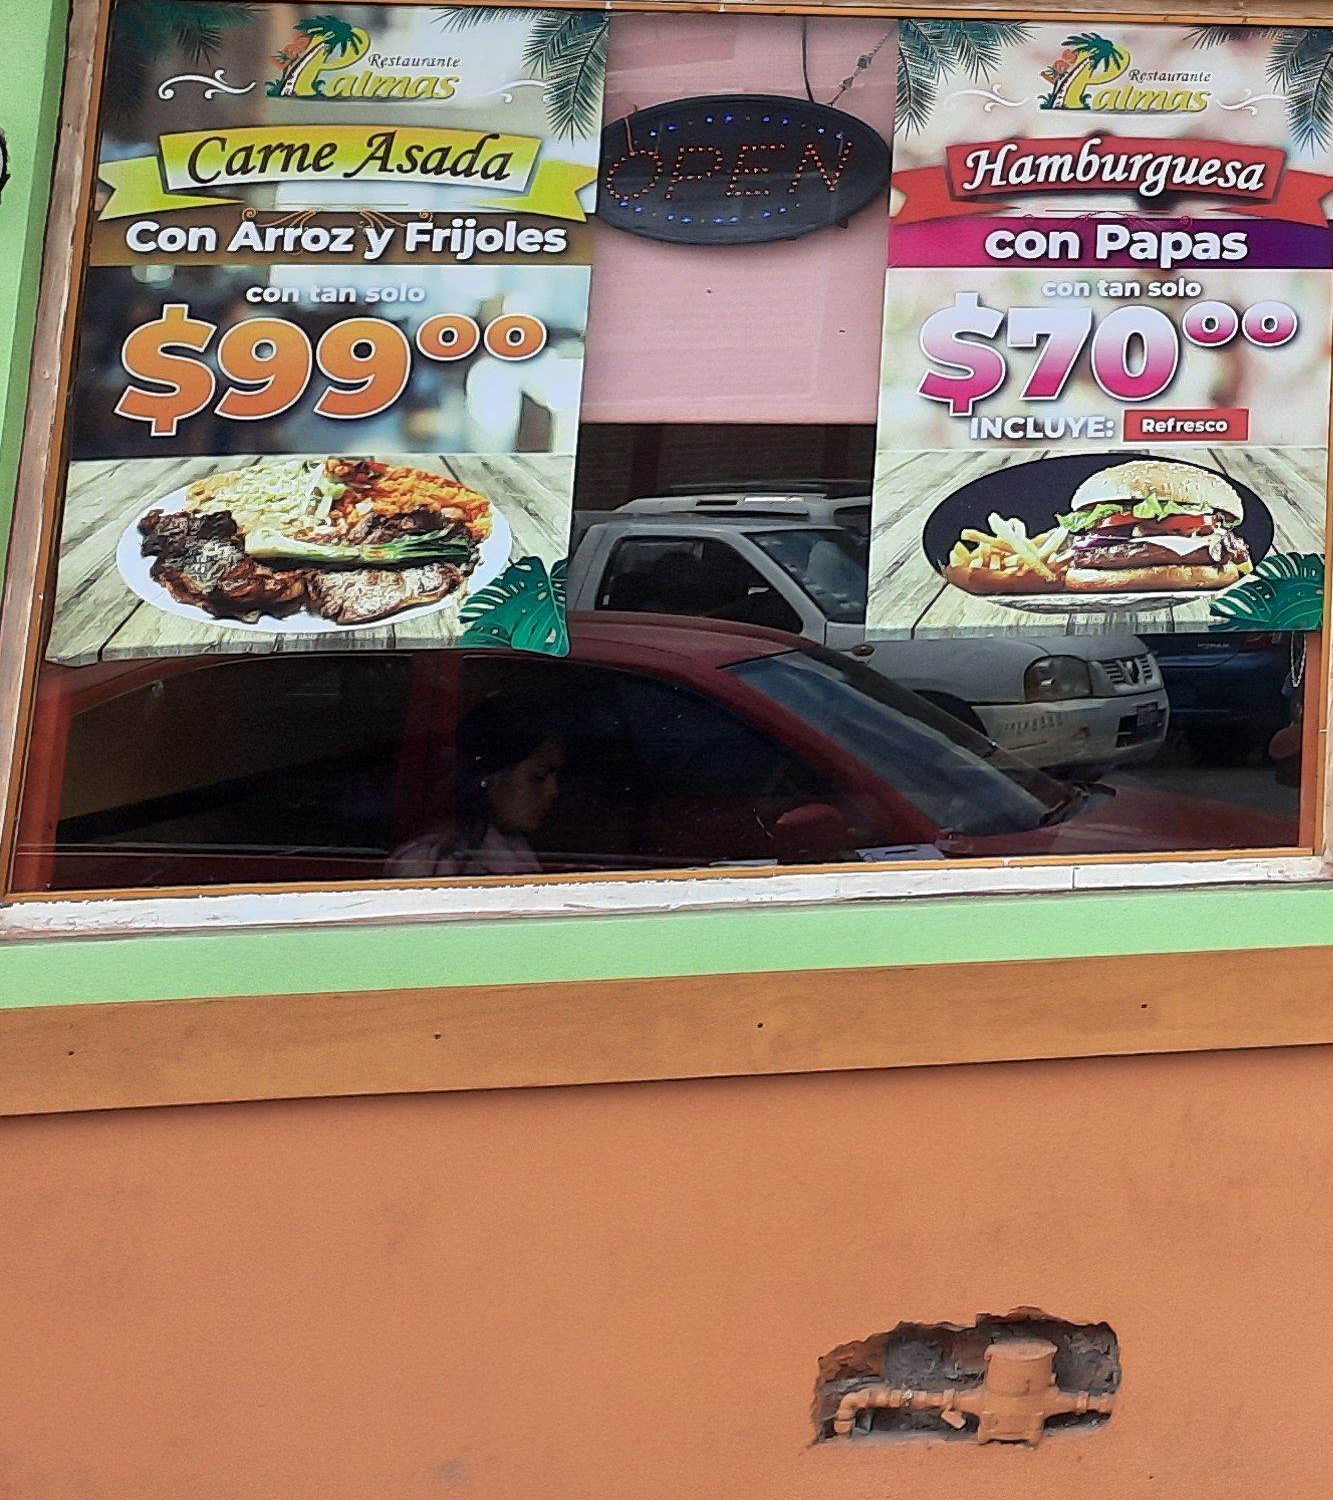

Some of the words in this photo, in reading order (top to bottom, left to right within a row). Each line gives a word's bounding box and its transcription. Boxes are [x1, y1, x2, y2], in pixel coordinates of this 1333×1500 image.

[284, 25, 460, 99] Palmas
[368, 54, 461, 69] Restaurante
[1053, 43, 1212, 112] Palmas
[1128, 69, 1212, 84] Restaurante
[187, 135, 336, 184] Carne
[344, 130, 515, 182] Asada
[604, 141, 853, 201] OPEN
[962, 138, 1267, 198] Hamburguesa
[126, 220, 217, 252] Con
[227, 220, 355, 253] Arroz
[363, 228, 394, 260] y
[405, 219, 567, 260] Frijoles
[984, 229, 1080, 260] con
[1096, 223, 1248, 269] Papas
[245, 284, 299, 303] con
[309, 283, 356, 303] tan
[365, 283, 426, 303] solo
[1042, 280, 1090, 298] con
[1096, 279, 1141, 298] tan
[1147, 277, 1202, 298] solo
[970, 416, 1115, 440] INCLUYE:
[1141, 416, 1228, 433] Refresco
